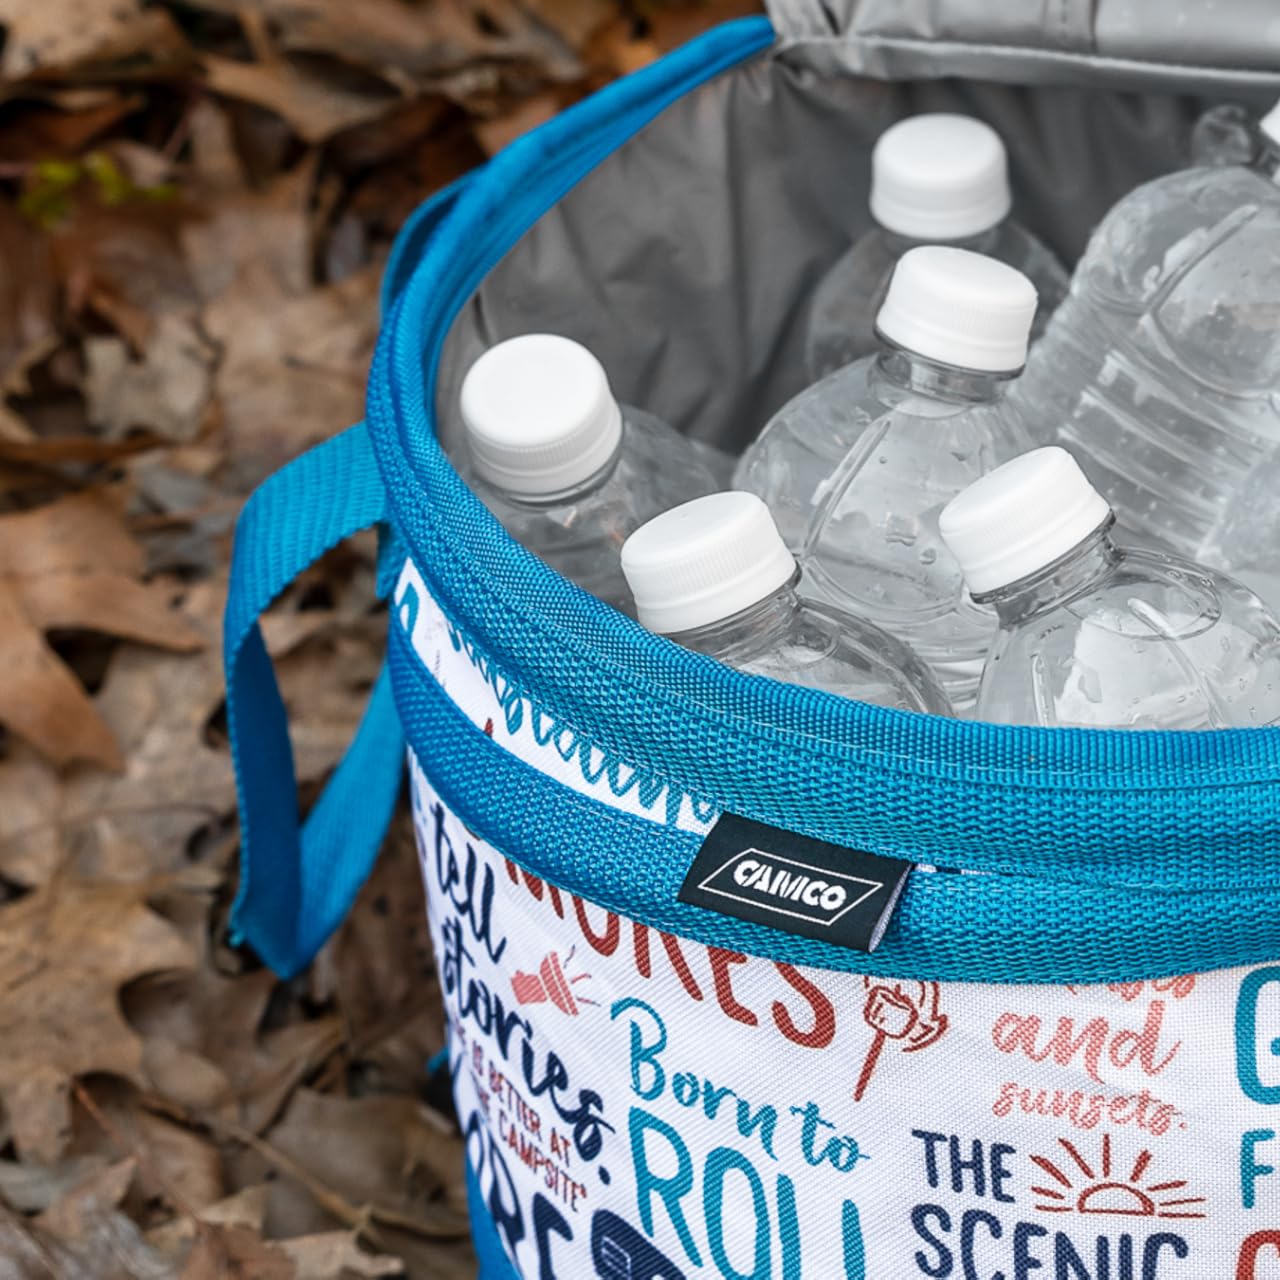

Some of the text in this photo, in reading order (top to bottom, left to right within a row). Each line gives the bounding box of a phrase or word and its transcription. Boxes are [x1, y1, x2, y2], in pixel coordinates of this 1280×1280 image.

[430, 801, 507, 964] tell
[733, 859, 847, 910] CAMCO
[992, 1000, 1182, 1084] and
[610, 996, 871, 1173] Born to
[992, 1082, 1188, 1136] sunsets.
[550, 1127, 572, 1168] AT
[911, 1129, 1016, 1204] THE
